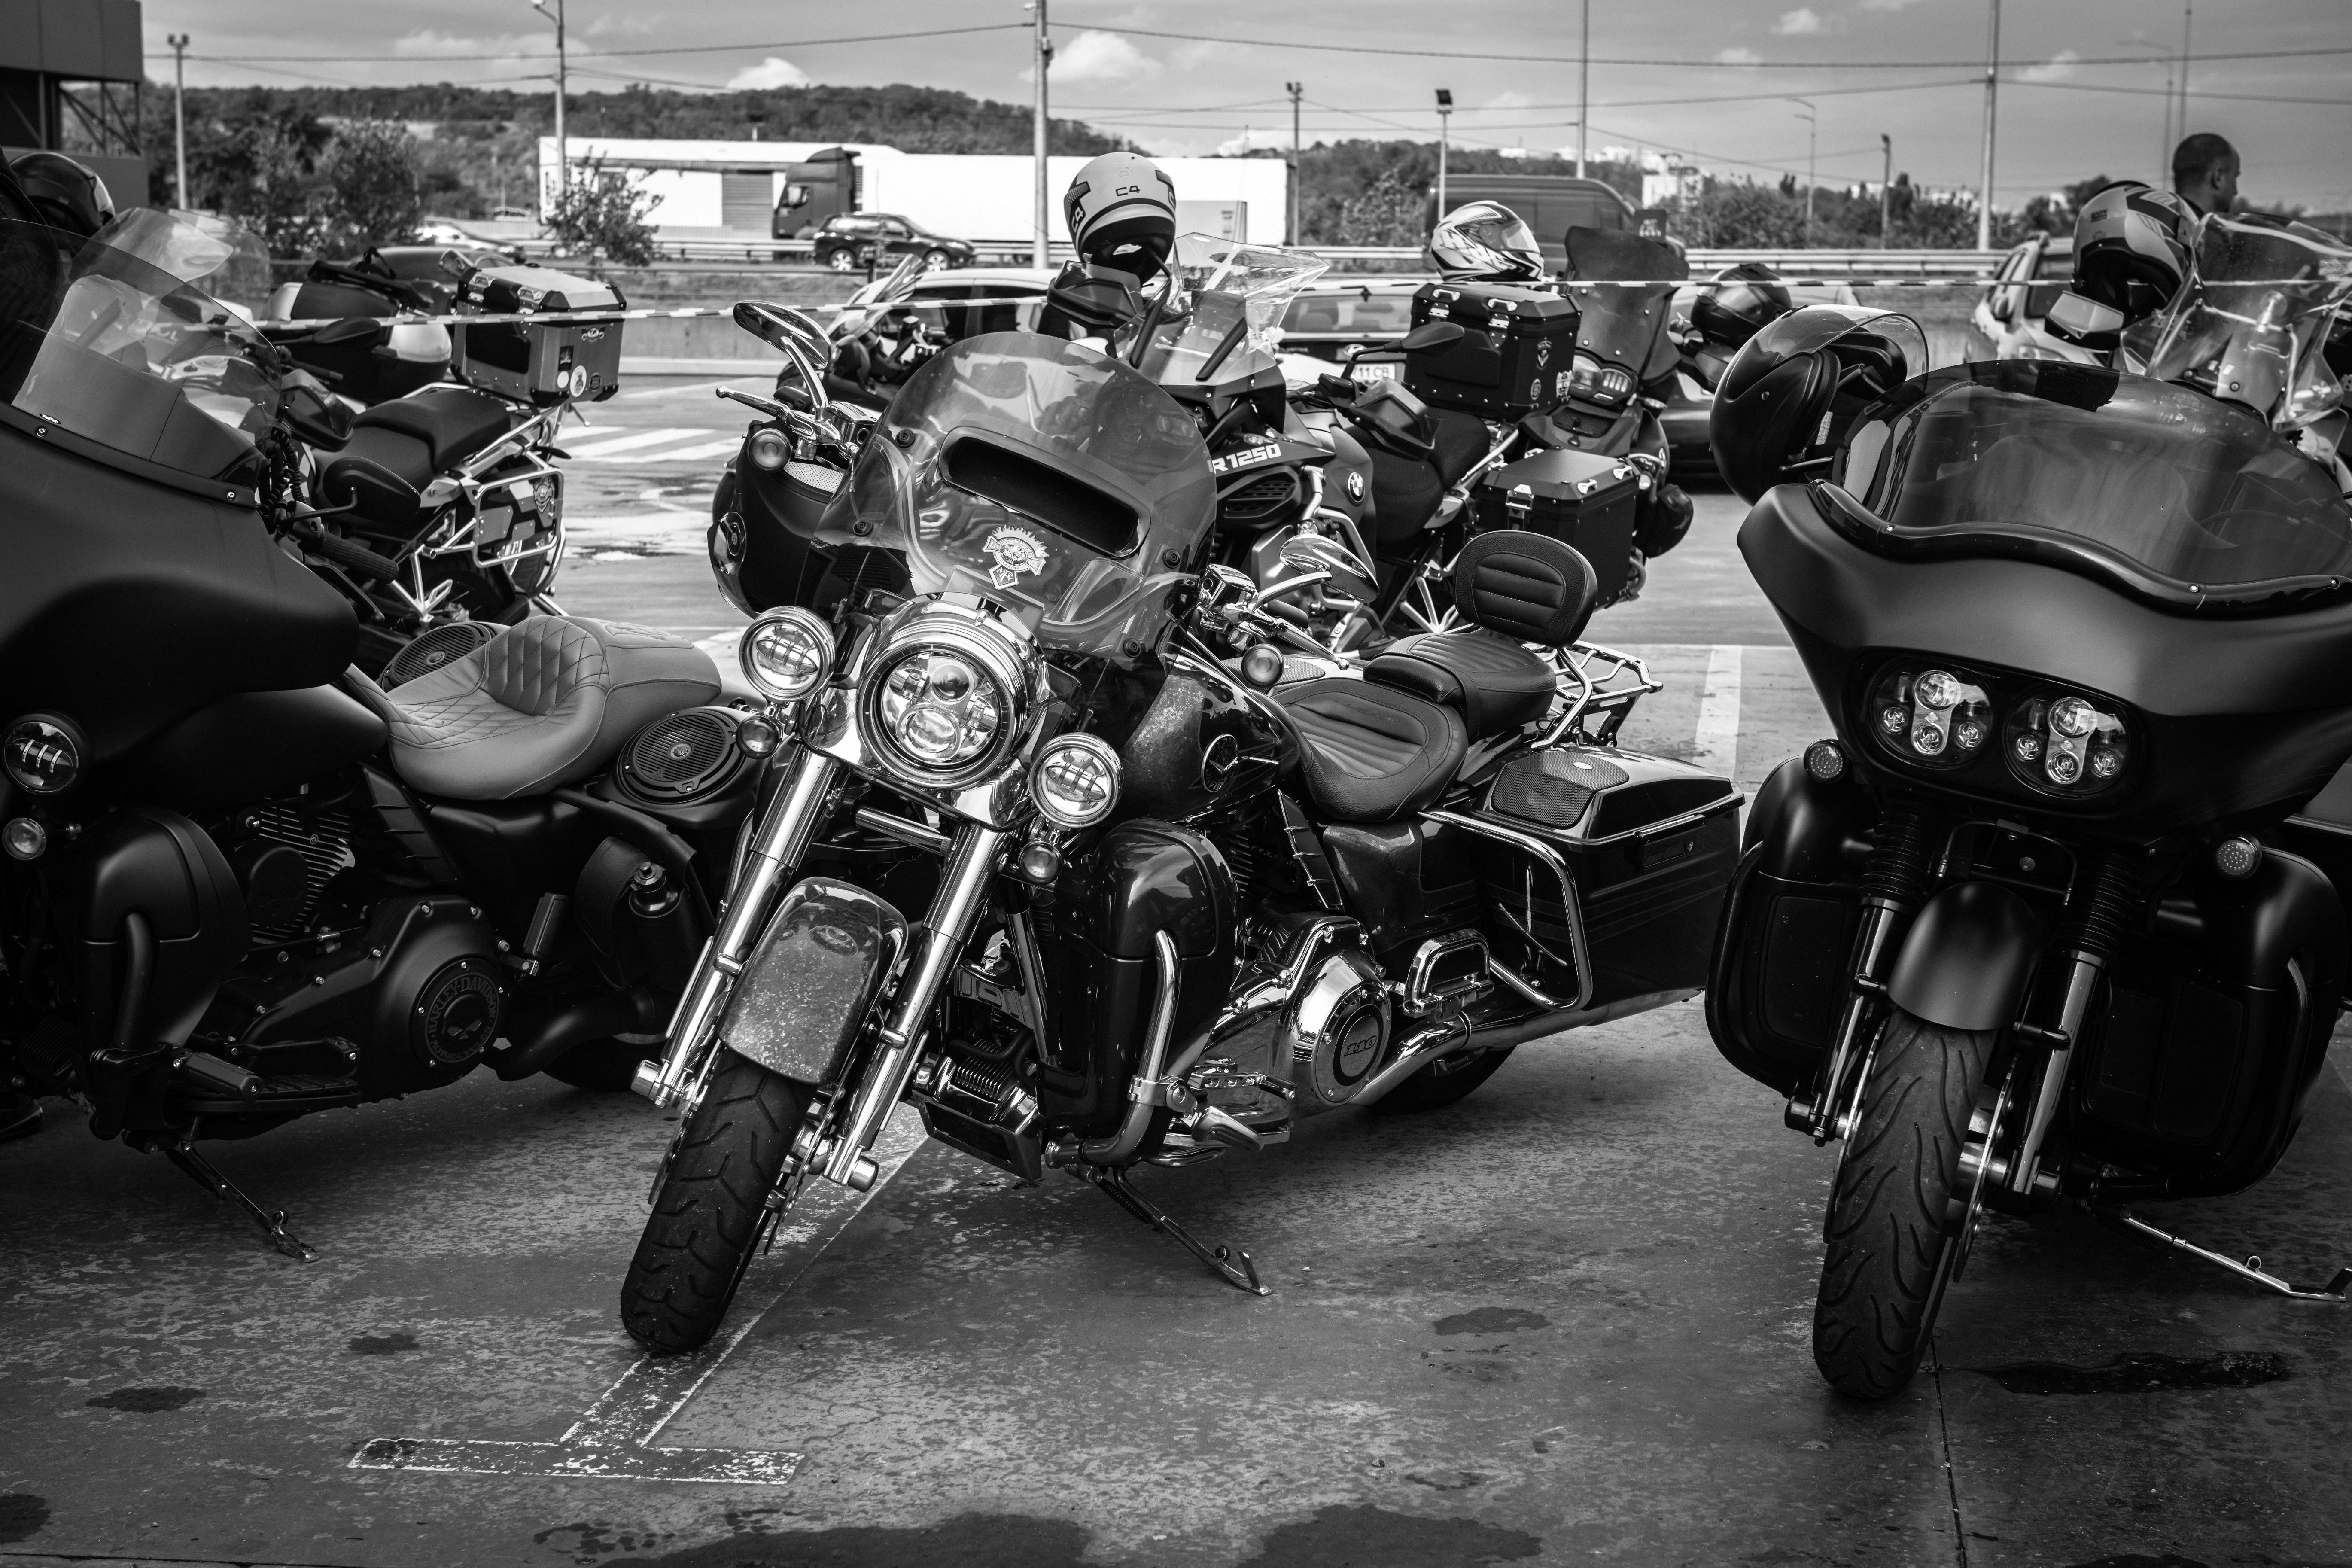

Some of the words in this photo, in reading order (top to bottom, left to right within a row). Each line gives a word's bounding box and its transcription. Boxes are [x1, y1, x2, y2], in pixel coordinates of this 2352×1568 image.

[1116, 186, 1140, 196] C4
[1071, 207, 1083, 233] C4
[1226, 443, 1281, 469] 1250
[989, 542, 1002, 551] LIVE
[1026, 558, 1039, 568] FREE
[1000, 559, 1019, 570] UKRAINE
[428, 976, 496, 1034] HARLEY-DAVIDSON
[430, 1026, 491, 1059] MOTORCYCLES
[1344, 1035, 1377, 1057] 110
